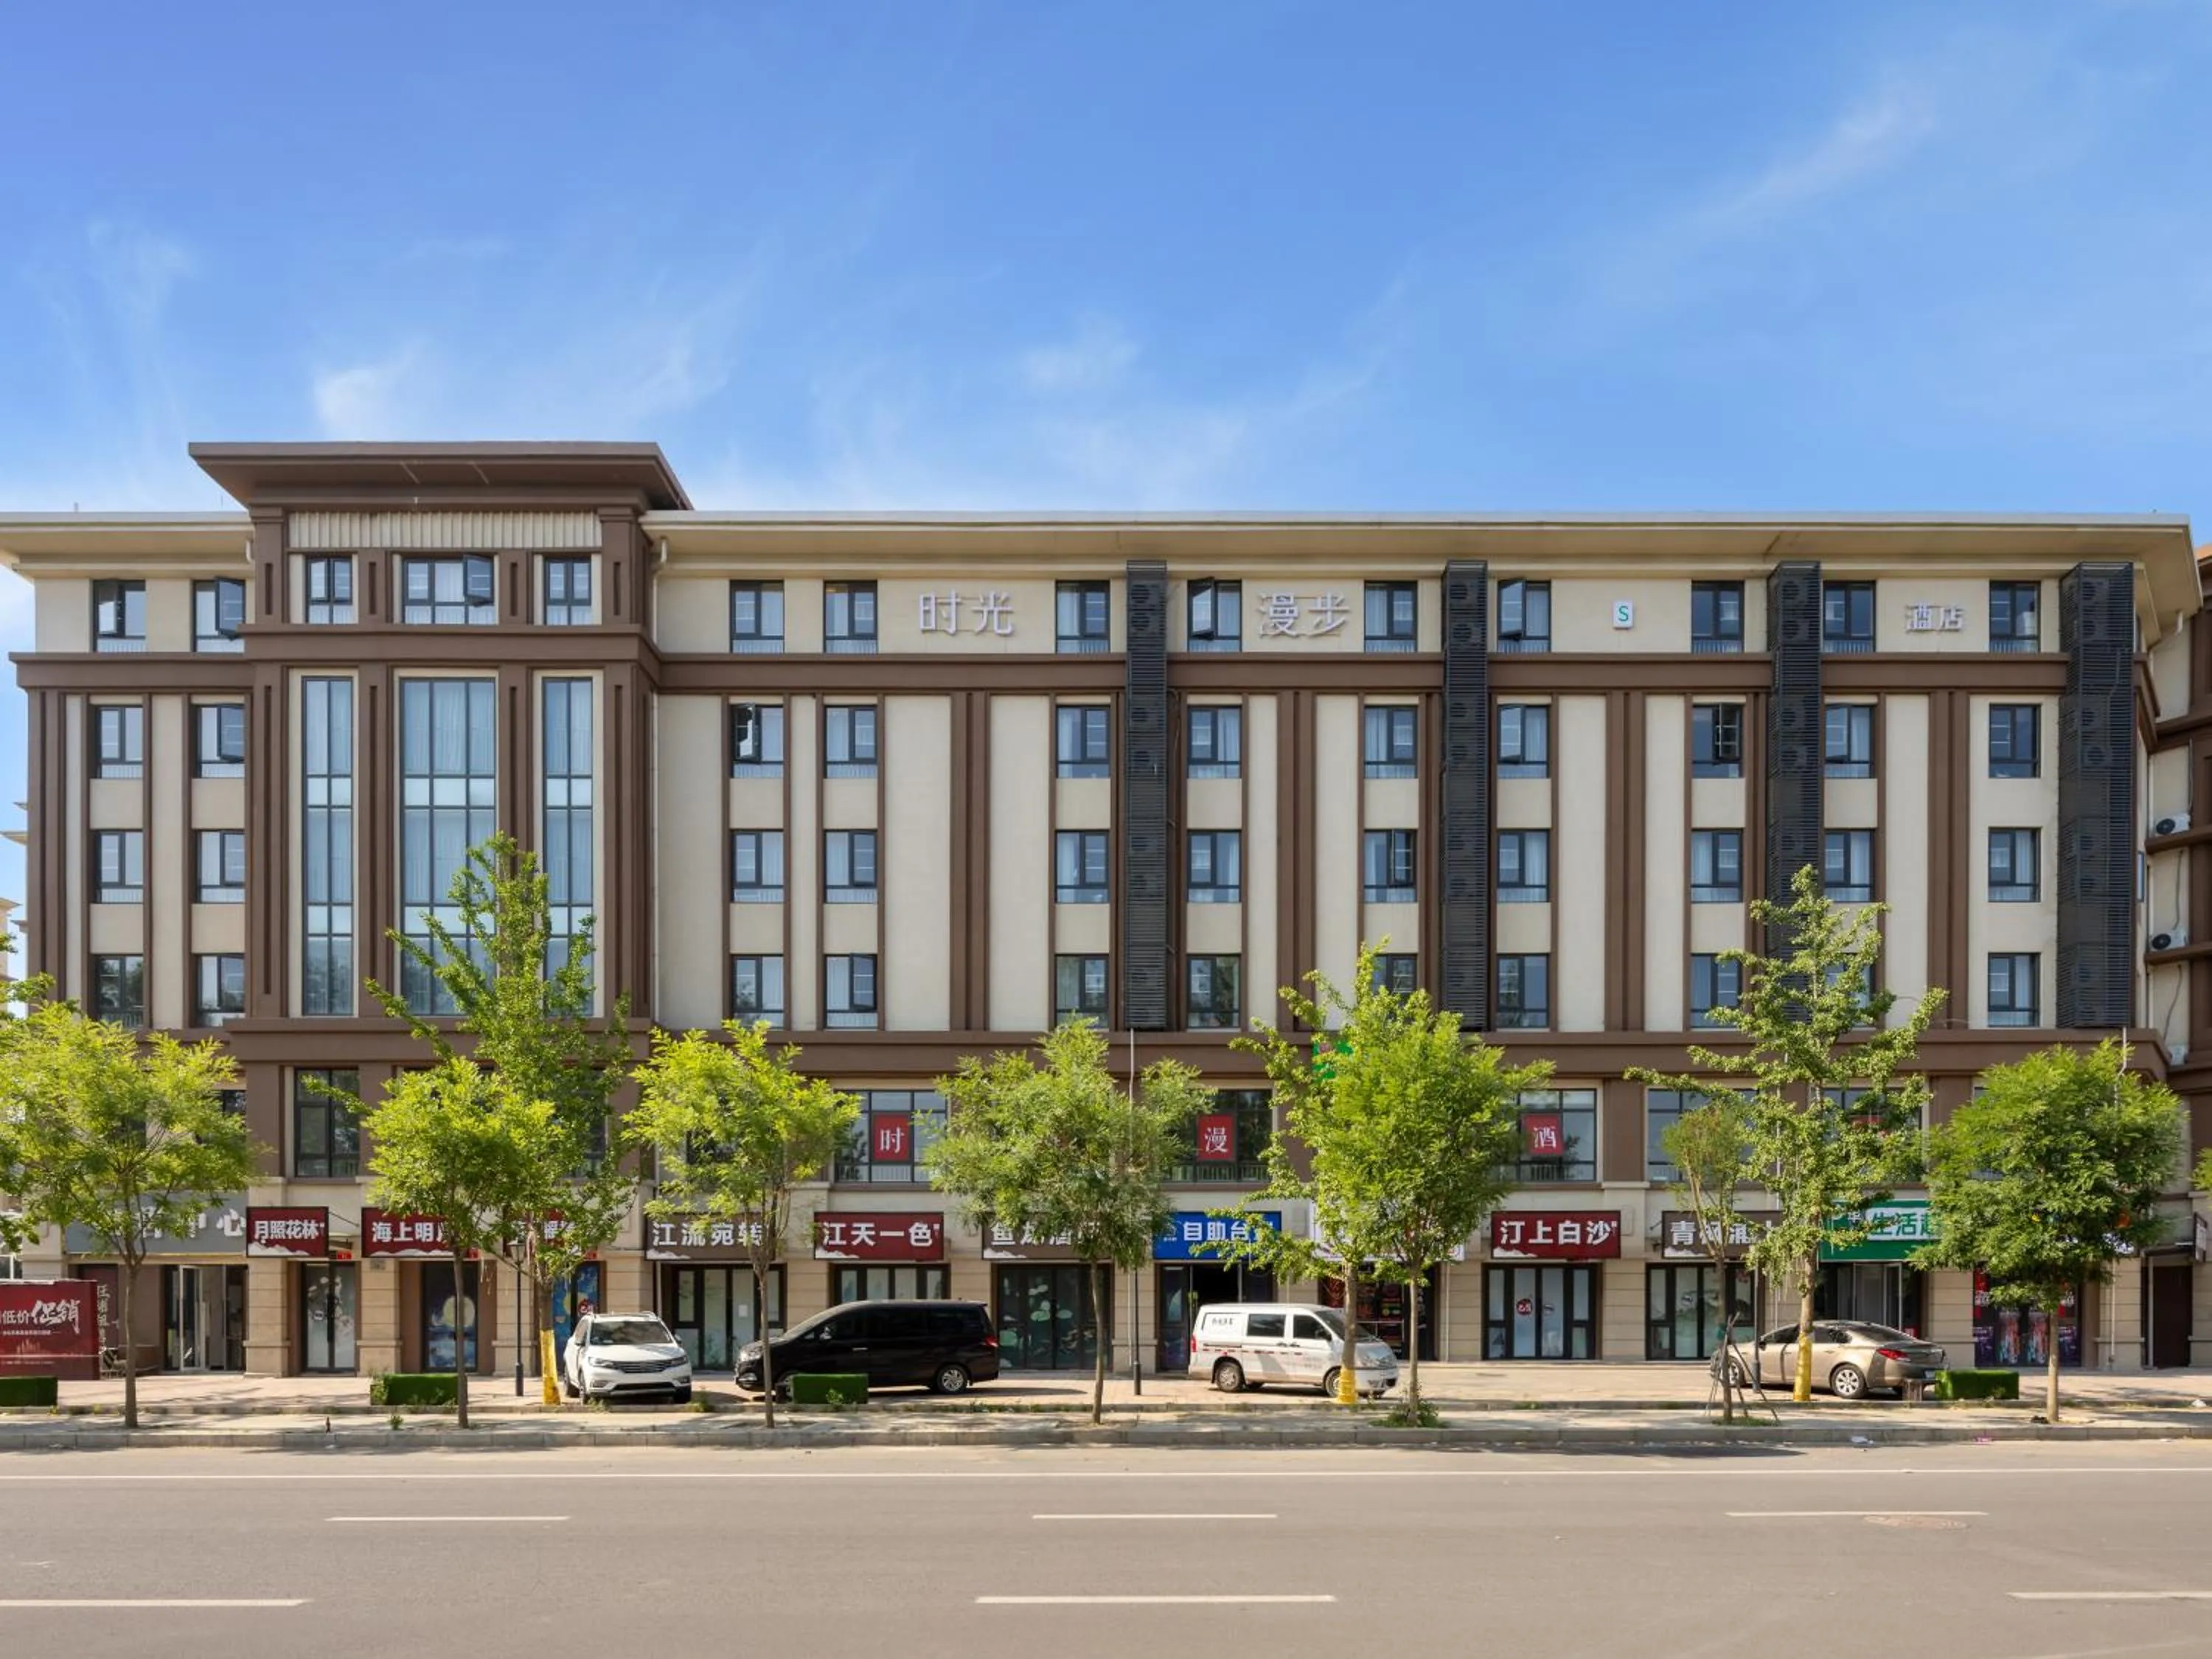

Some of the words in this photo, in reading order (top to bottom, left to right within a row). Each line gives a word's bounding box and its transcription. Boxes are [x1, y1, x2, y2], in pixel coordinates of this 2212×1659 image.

[919, 591, 1015, 636] 时光
[1258, 591, 1350, 638] 漫步
[1618, 605, 1630, 622] S
[1905, 603, 1964, 633] 酒店
[880, 1127, 905, 1155] 时
[1204, 1126, 1228, 1154] 漫
[1533, 1125, 1557, 1150] 酒
[254, 1220, 319, 1239] 月照花林
[823, 1222, 933, 1246] 江天一色
[1183, 1220, 1274, 1243] 自助台
[1500, 1220, 1611, 1245] 汀上白沙
[0, 1299, 80, 1335] 低价促销
